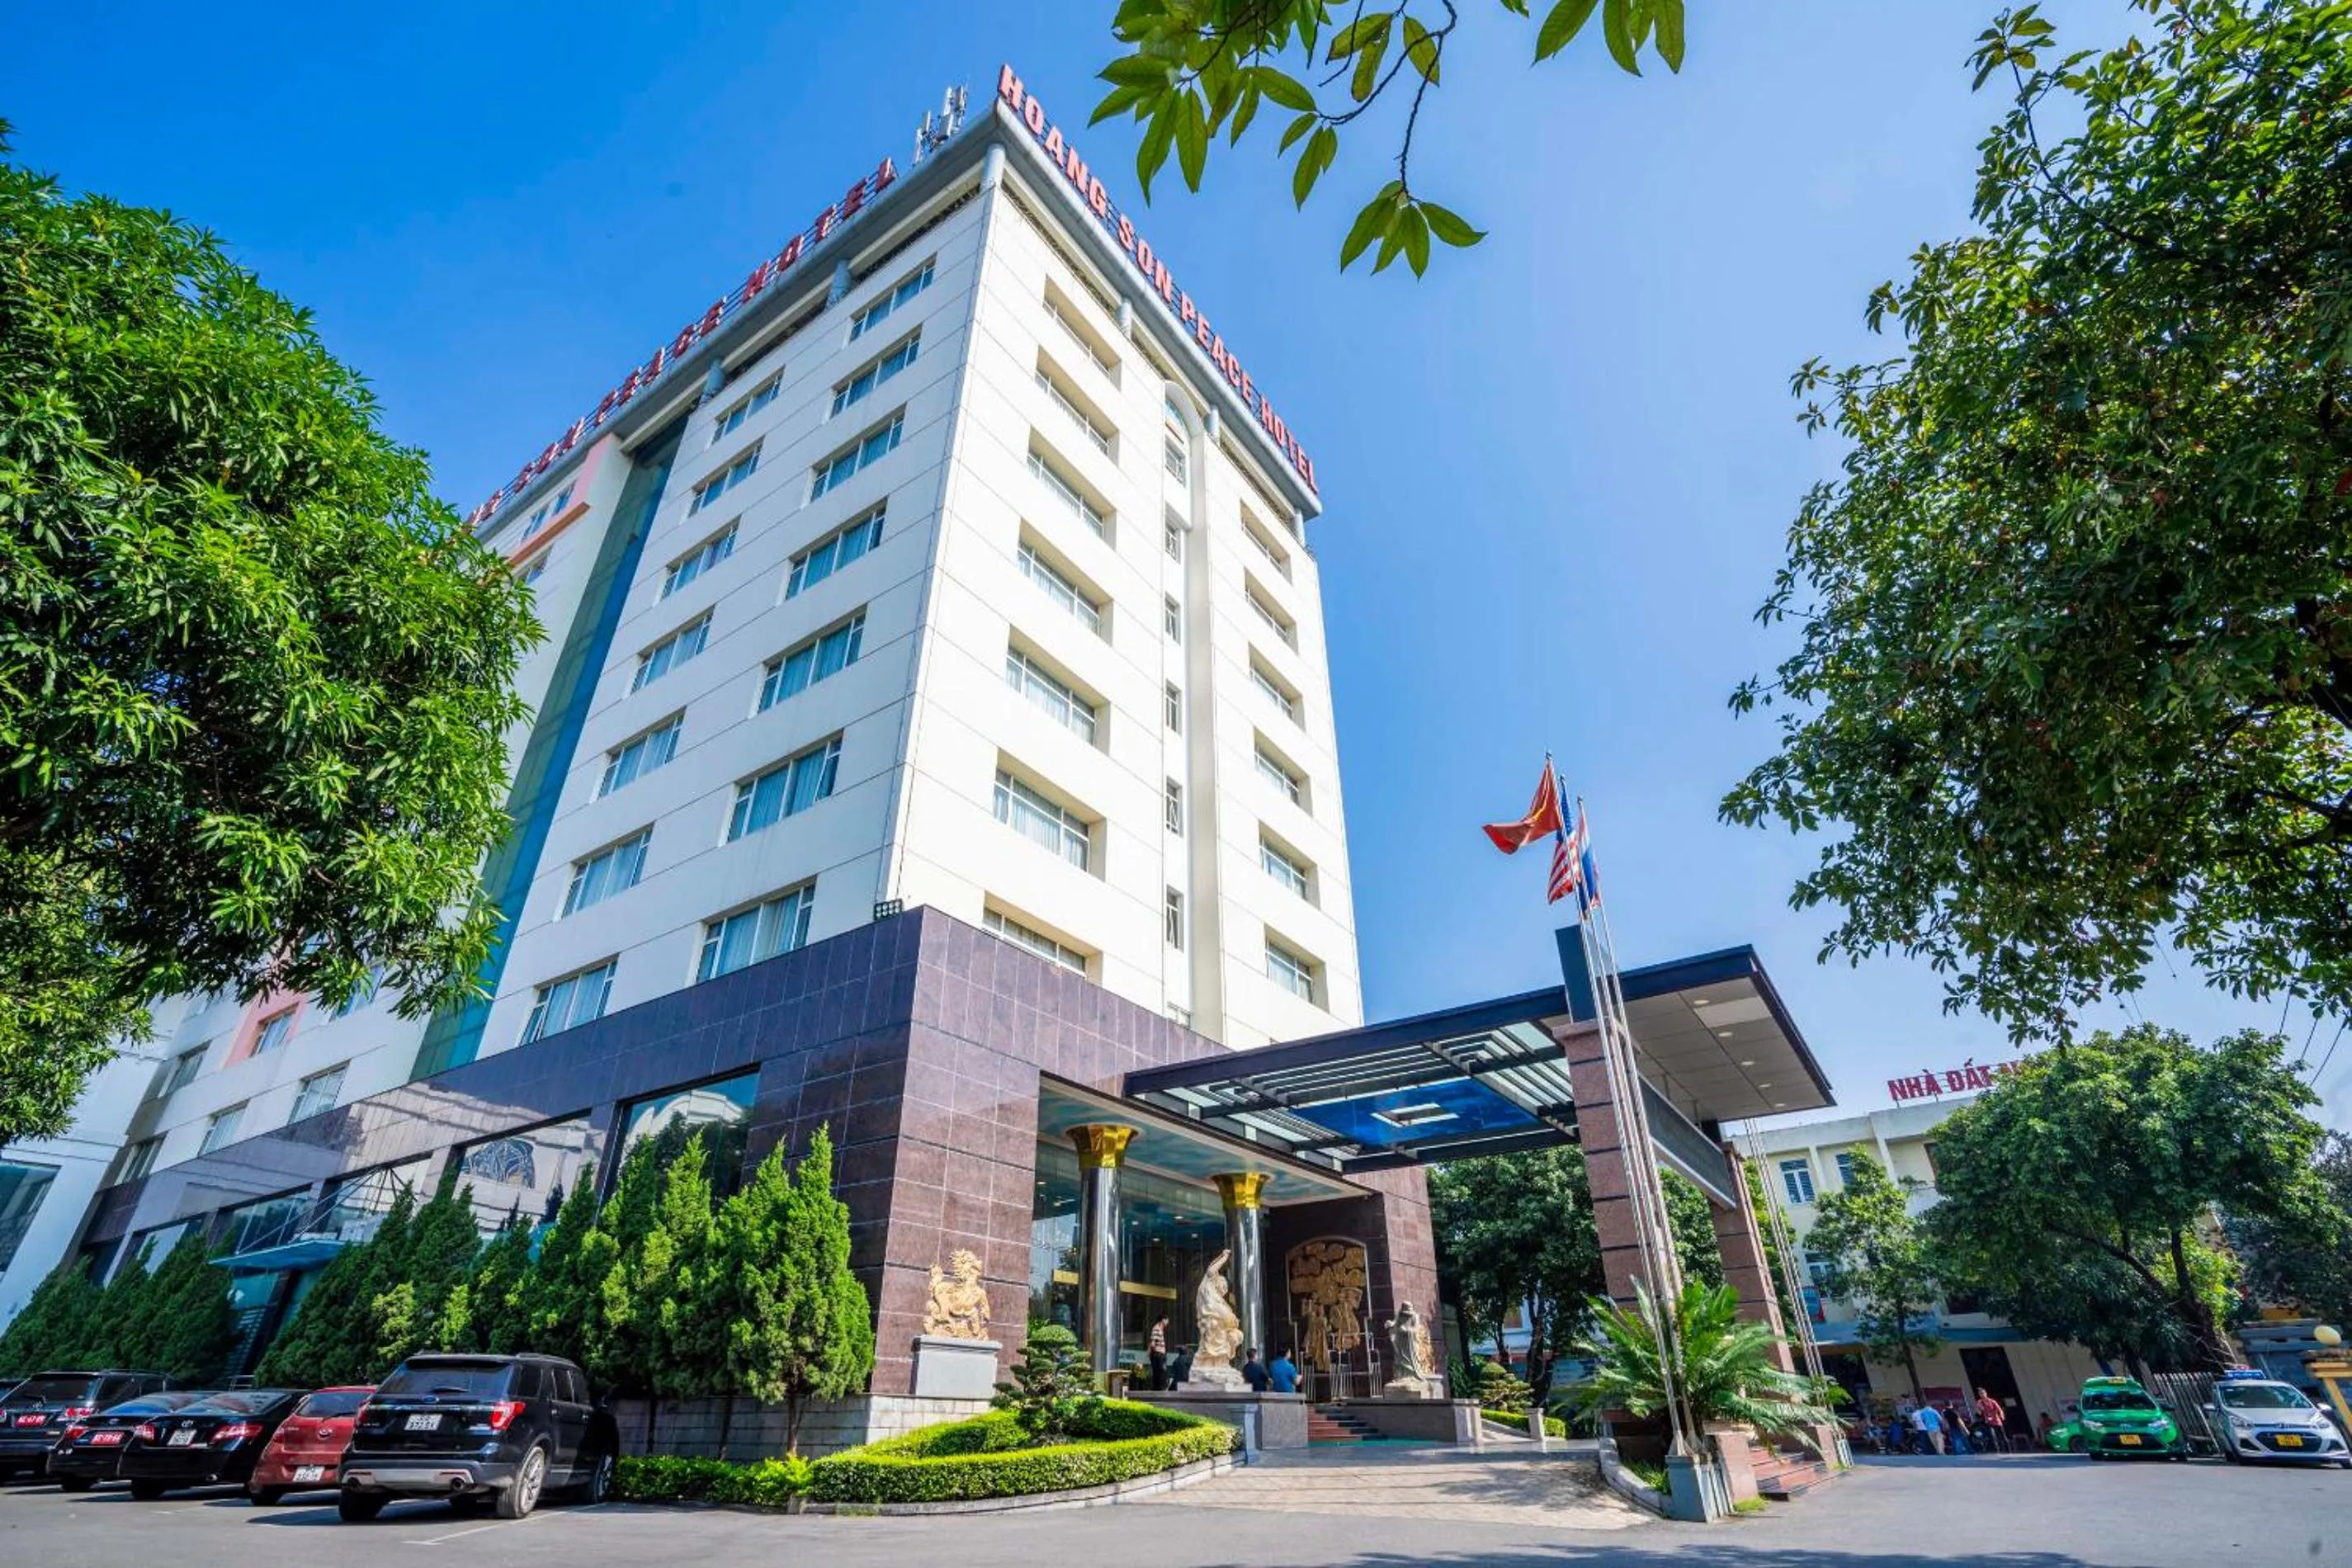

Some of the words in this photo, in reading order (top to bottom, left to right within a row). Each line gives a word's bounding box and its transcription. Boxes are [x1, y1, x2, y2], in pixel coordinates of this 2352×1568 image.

[741, 156, 896, 305] HOTEL
[998, 63, 1107, 219] HOANG
[1118, 213, 1173, 304] SON
[1180, 290, 1254, 408] PEACE
[1260, 394, 1319, 495] HOTEL
[1887, 1069, 1943, 1101] NHÀ
